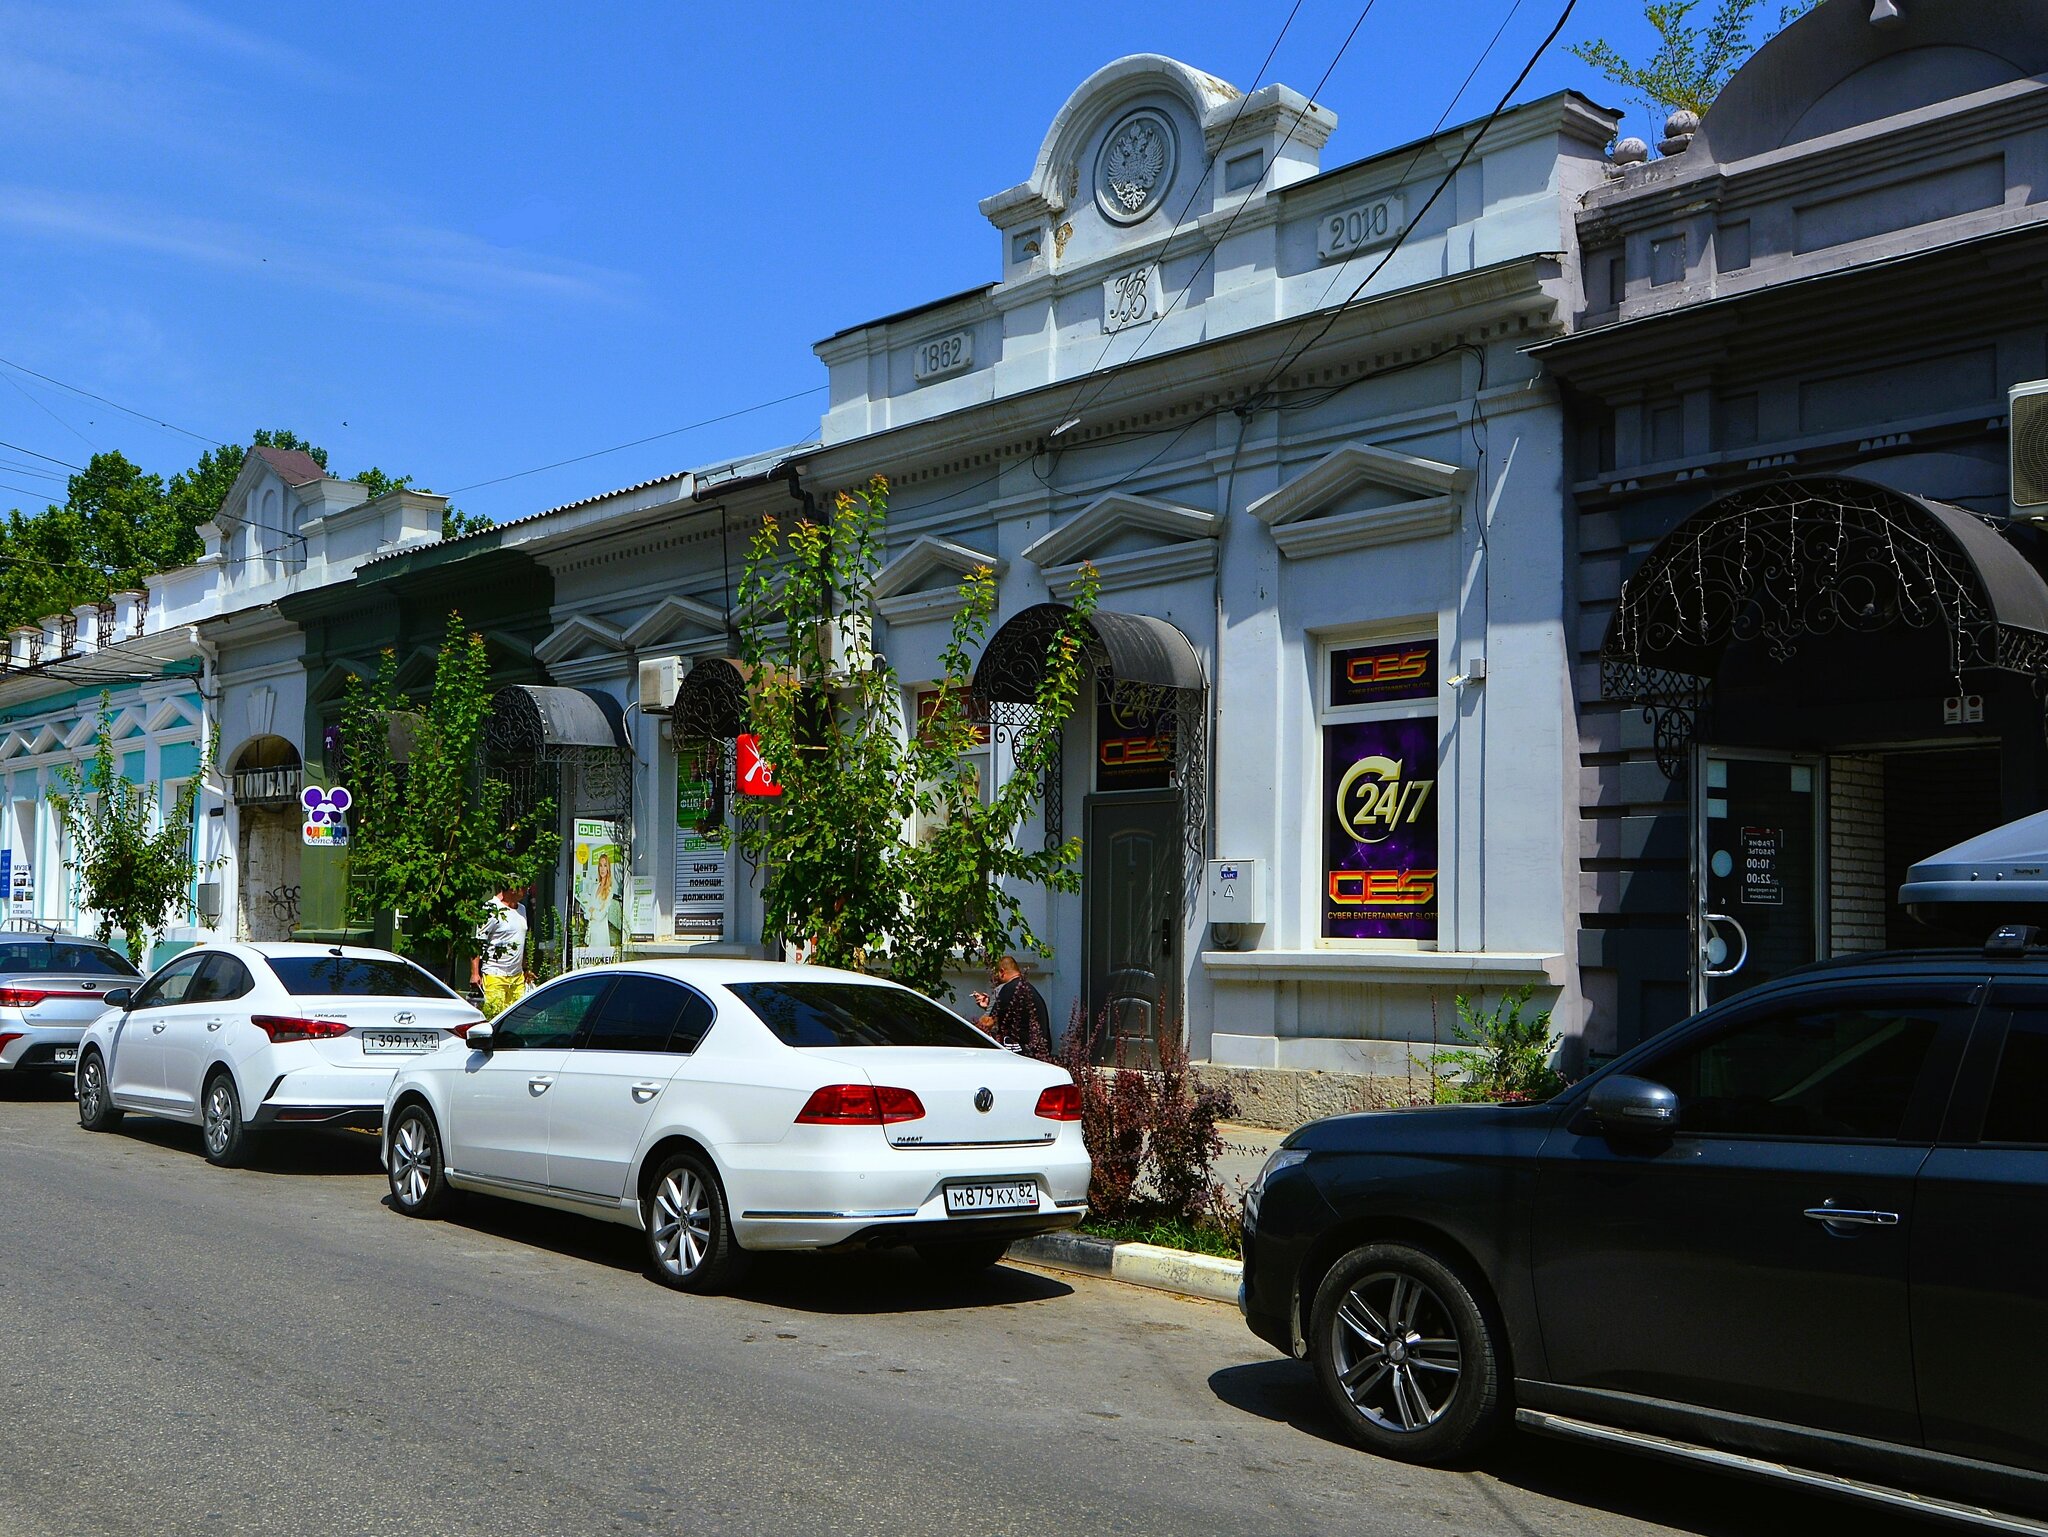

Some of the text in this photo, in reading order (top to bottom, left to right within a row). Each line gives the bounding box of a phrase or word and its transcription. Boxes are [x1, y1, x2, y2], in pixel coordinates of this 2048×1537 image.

[1329, 203, 1388, 250] 2010
[921, 337, 961, 374] 1862
[1353, 780, 1434, 832] 24/7
[306, 826, 347, 838] ОДЕЖДА
[579, 824, 603, 837] ФЦБ
[693, 863, 718, 873] Центр
[689, 879, 722, 887] помощи
[1328, 911, 1352, 920] CYBER
[1354, 911, 1414, 920] ENTERTAINMENT
[678, 918, 711, 926] Обратитесь
[422, 1034, 434, 1045] 31
[953, 1183, 1033, 1207] М879КХ 82
